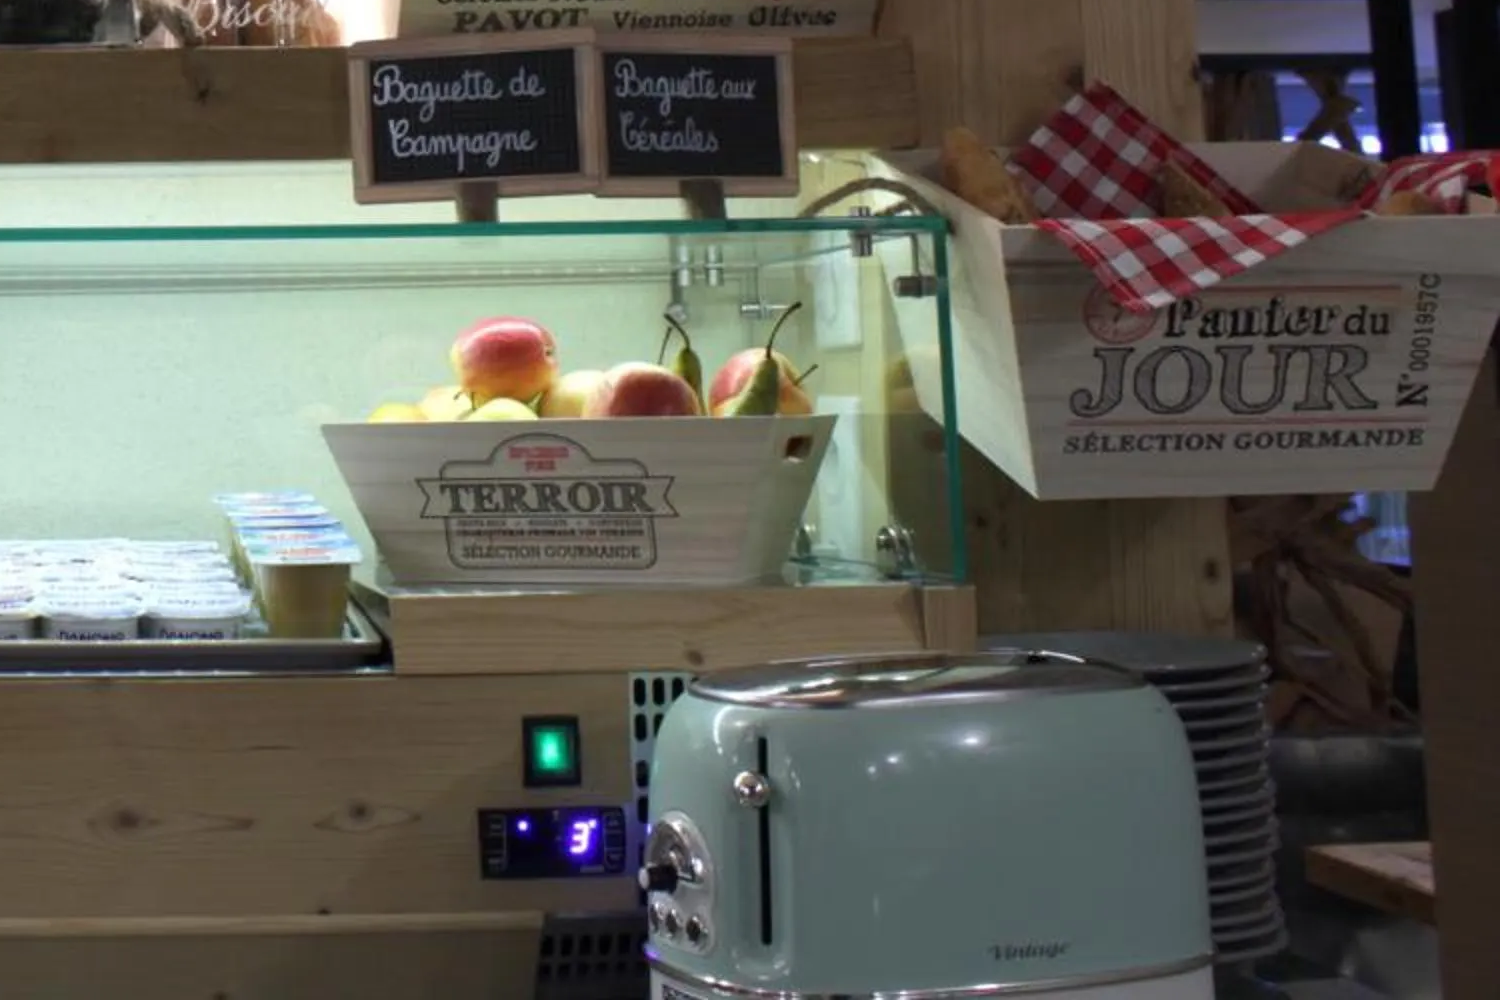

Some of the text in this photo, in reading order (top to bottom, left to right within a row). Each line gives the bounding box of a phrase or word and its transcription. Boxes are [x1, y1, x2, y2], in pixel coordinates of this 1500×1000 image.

[452, 6, 838, 33] PAVOT Viennoise Olives
[372, 63, 546, 122] Baguette de
[613, 58, 757, 116] Baguette aux
[388, 118, 538, 172] Campagne
[619, 111, 720, 153] Céréales
[1164, 296, 1391, 340] Panier du
[1067, 343, 1380, 419] JOUR
[1063, 428, 1426, 455] SÉLECTION GOURMANDE
[440, 481, 655, 514] TERROIR
[544, 544, 642, 560] GOURMANDE
